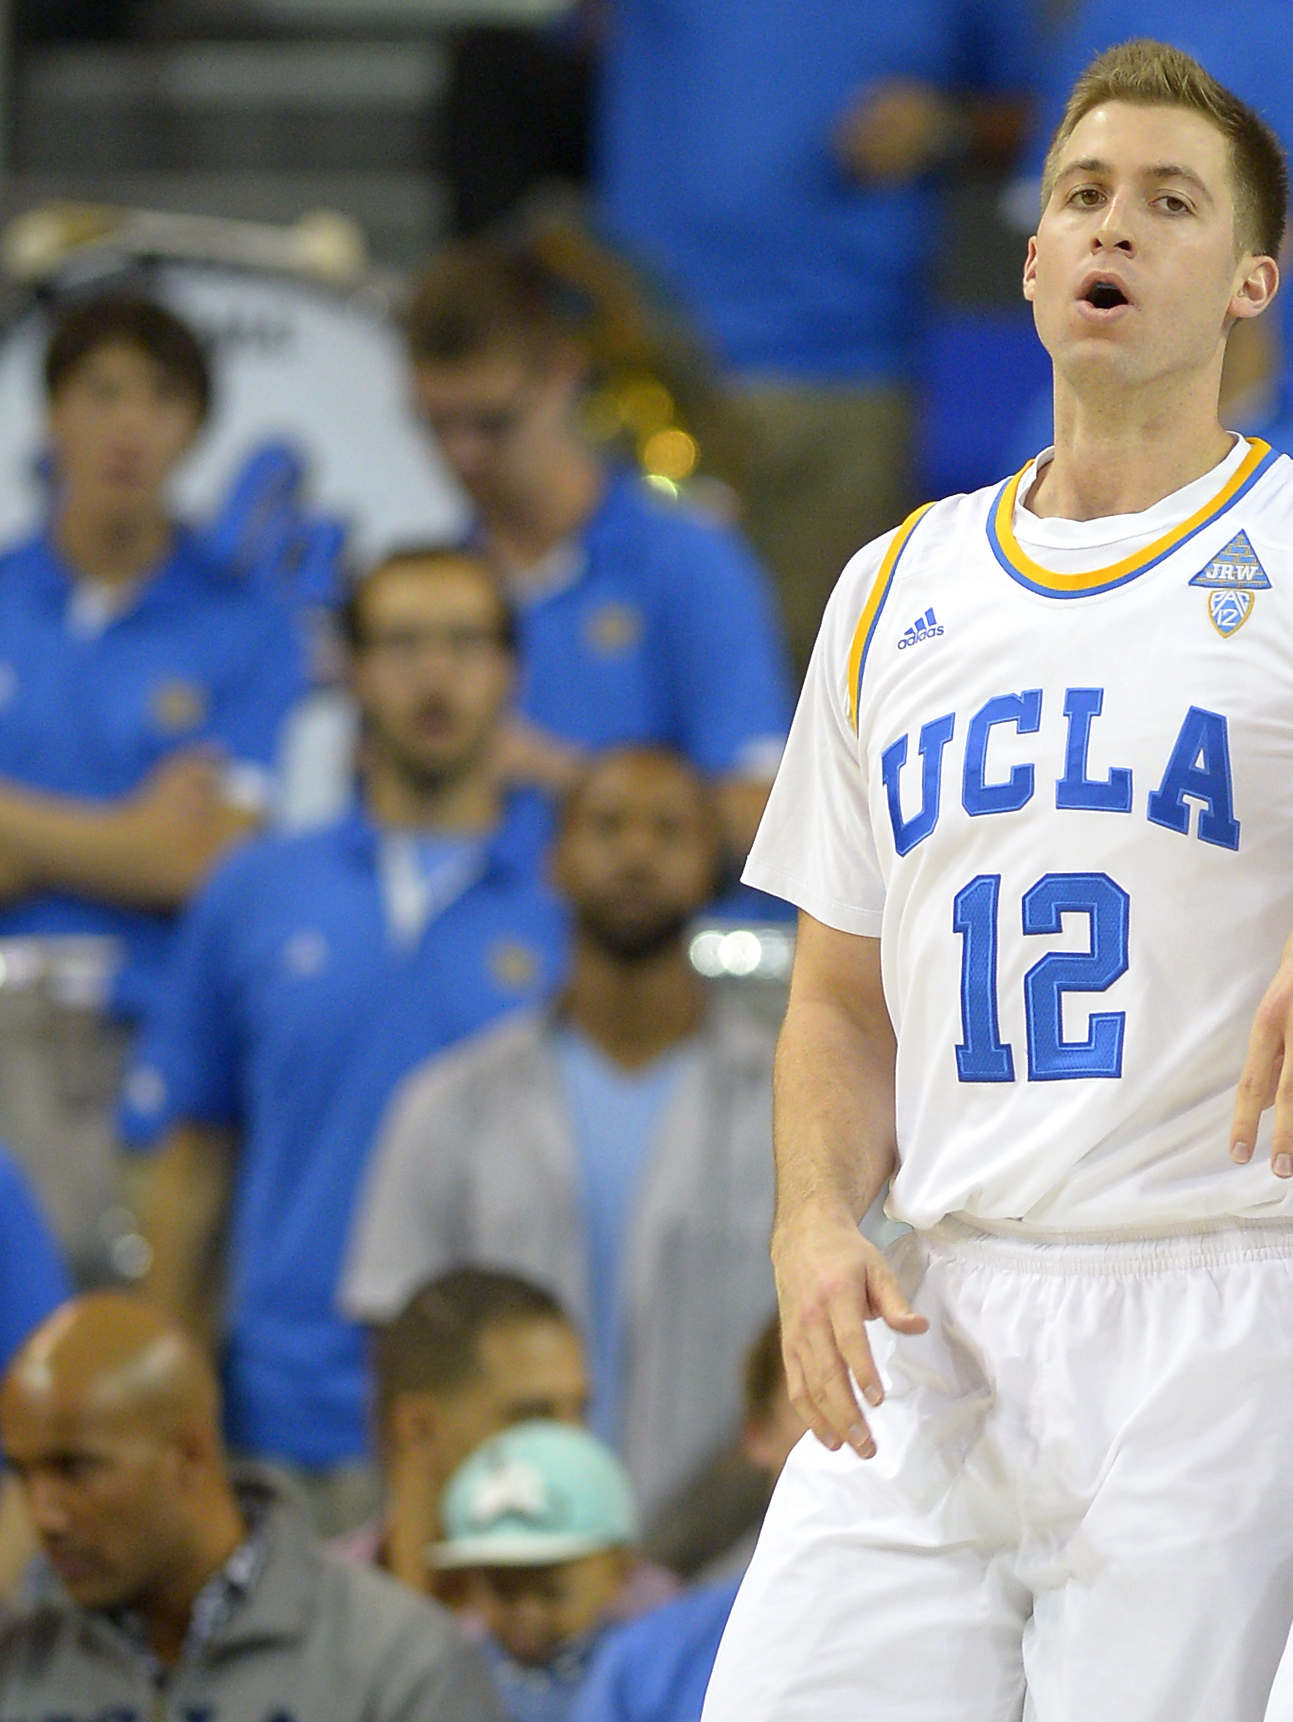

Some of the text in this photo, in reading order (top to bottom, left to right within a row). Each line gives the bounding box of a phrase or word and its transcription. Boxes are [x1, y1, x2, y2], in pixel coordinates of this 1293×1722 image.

[1205, 563, 1258, 580] JRW
[1216, 608, 1239, 626] 12
[897, 625, 945, 650] adidas
[881, 687, 1241, 857] UCLA
[953, 872, 1130, 1082] 12
